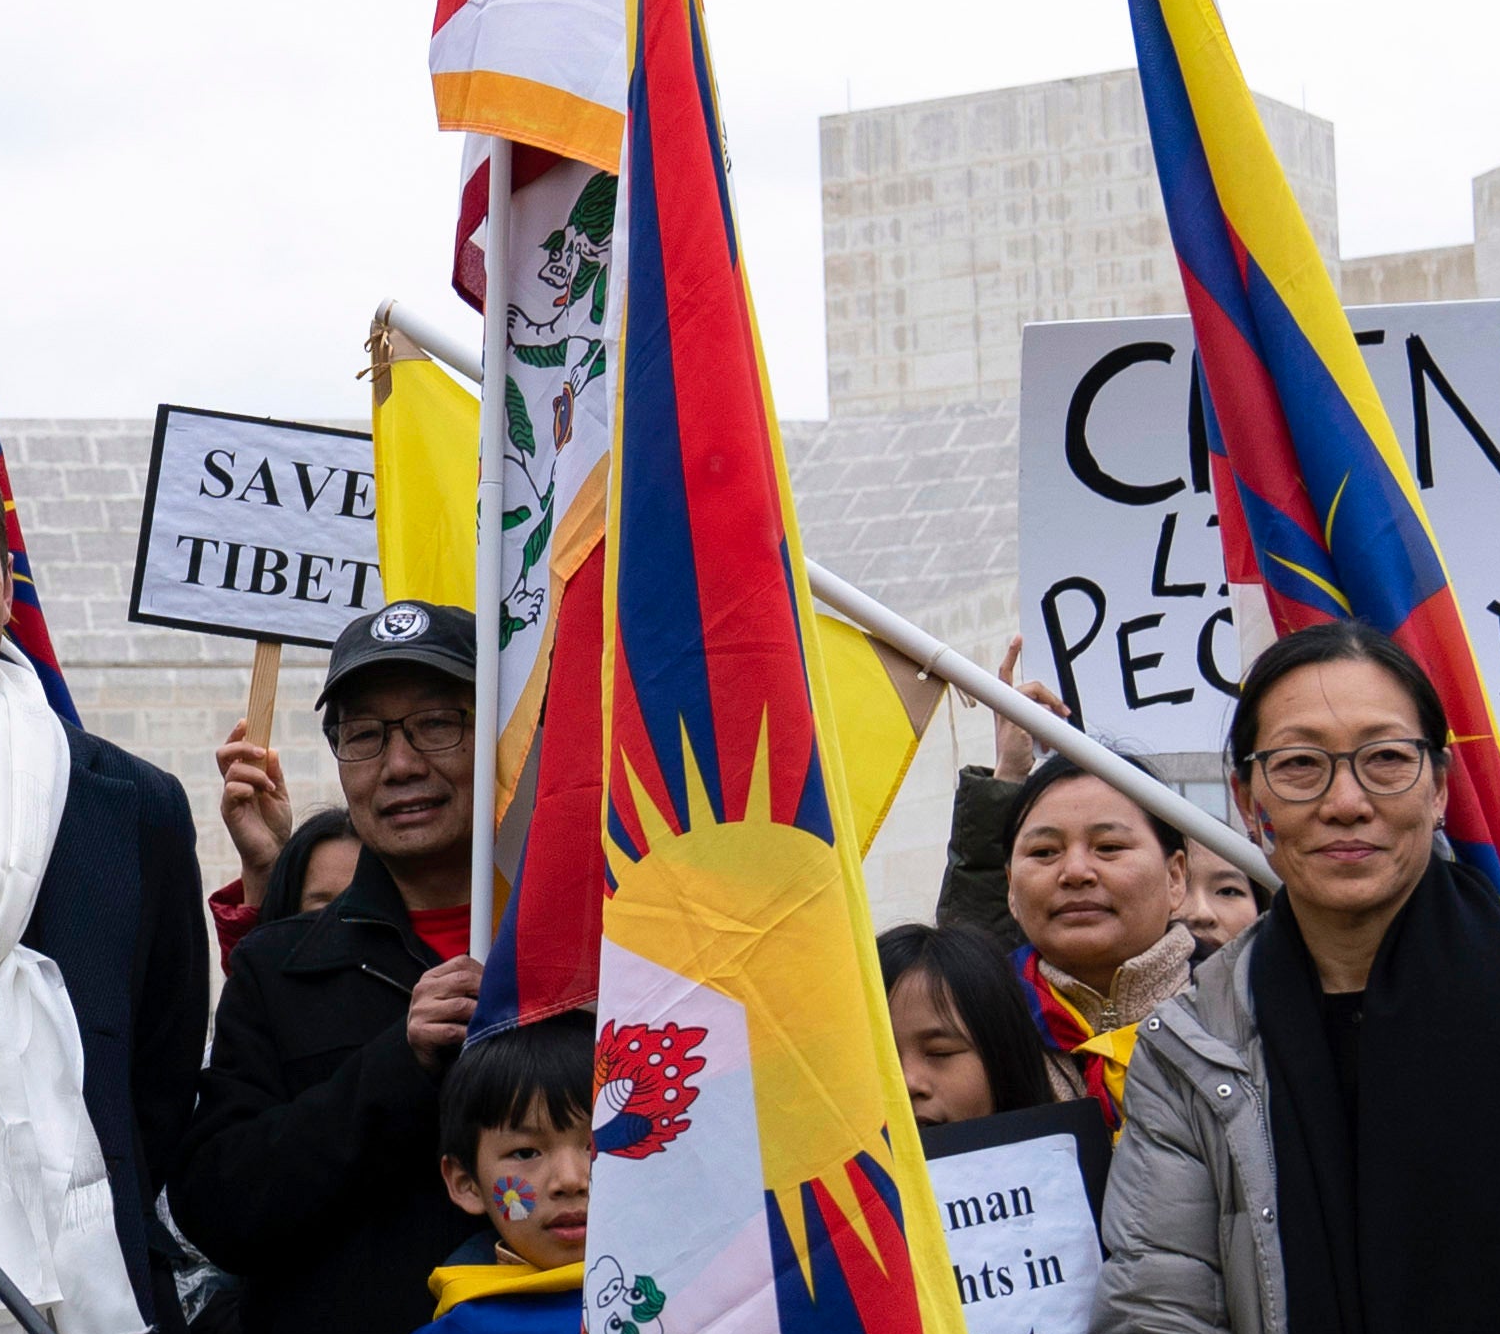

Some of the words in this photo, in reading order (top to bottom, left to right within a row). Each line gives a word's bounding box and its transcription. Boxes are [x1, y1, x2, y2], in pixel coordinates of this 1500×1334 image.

[199, 449, 376, 522] SAVE
[176, 534, 381, 609] TIBET
[944, 1185, 1035, 1233] man
[1024, 1249, 1066, 1290] in
